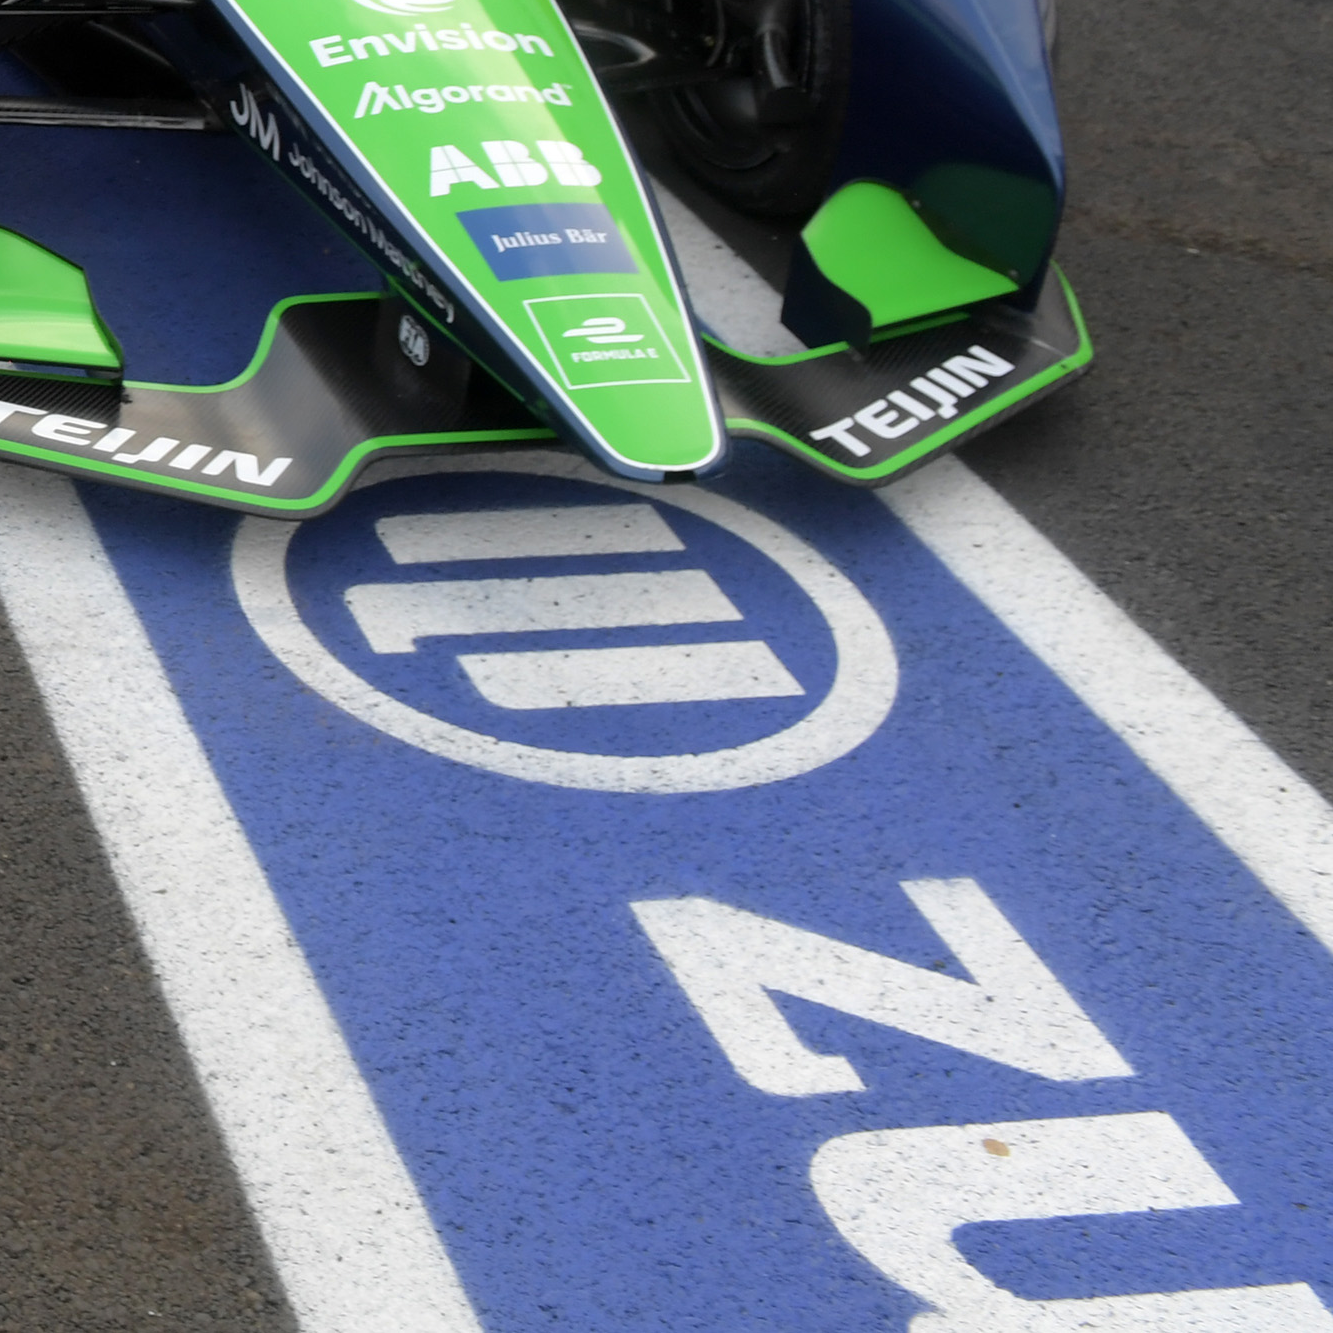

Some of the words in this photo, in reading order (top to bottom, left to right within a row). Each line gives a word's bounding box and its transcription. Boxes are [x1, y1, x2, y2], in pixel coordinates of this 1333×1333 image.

[309, 22, 554, 68] Envision
[230, 83, 280, 161] JM
[354, 81, 573, 119] Algorand
[430, 140, 602, 197] ABB
[490, 230, 563, 253] Julius
[565, 228, 609, 245] Bär
[570, 349, 646, 363] FORMULA
[648, 348, 659, 359] E
[809, 344, 1016, 457] TEIJIN
